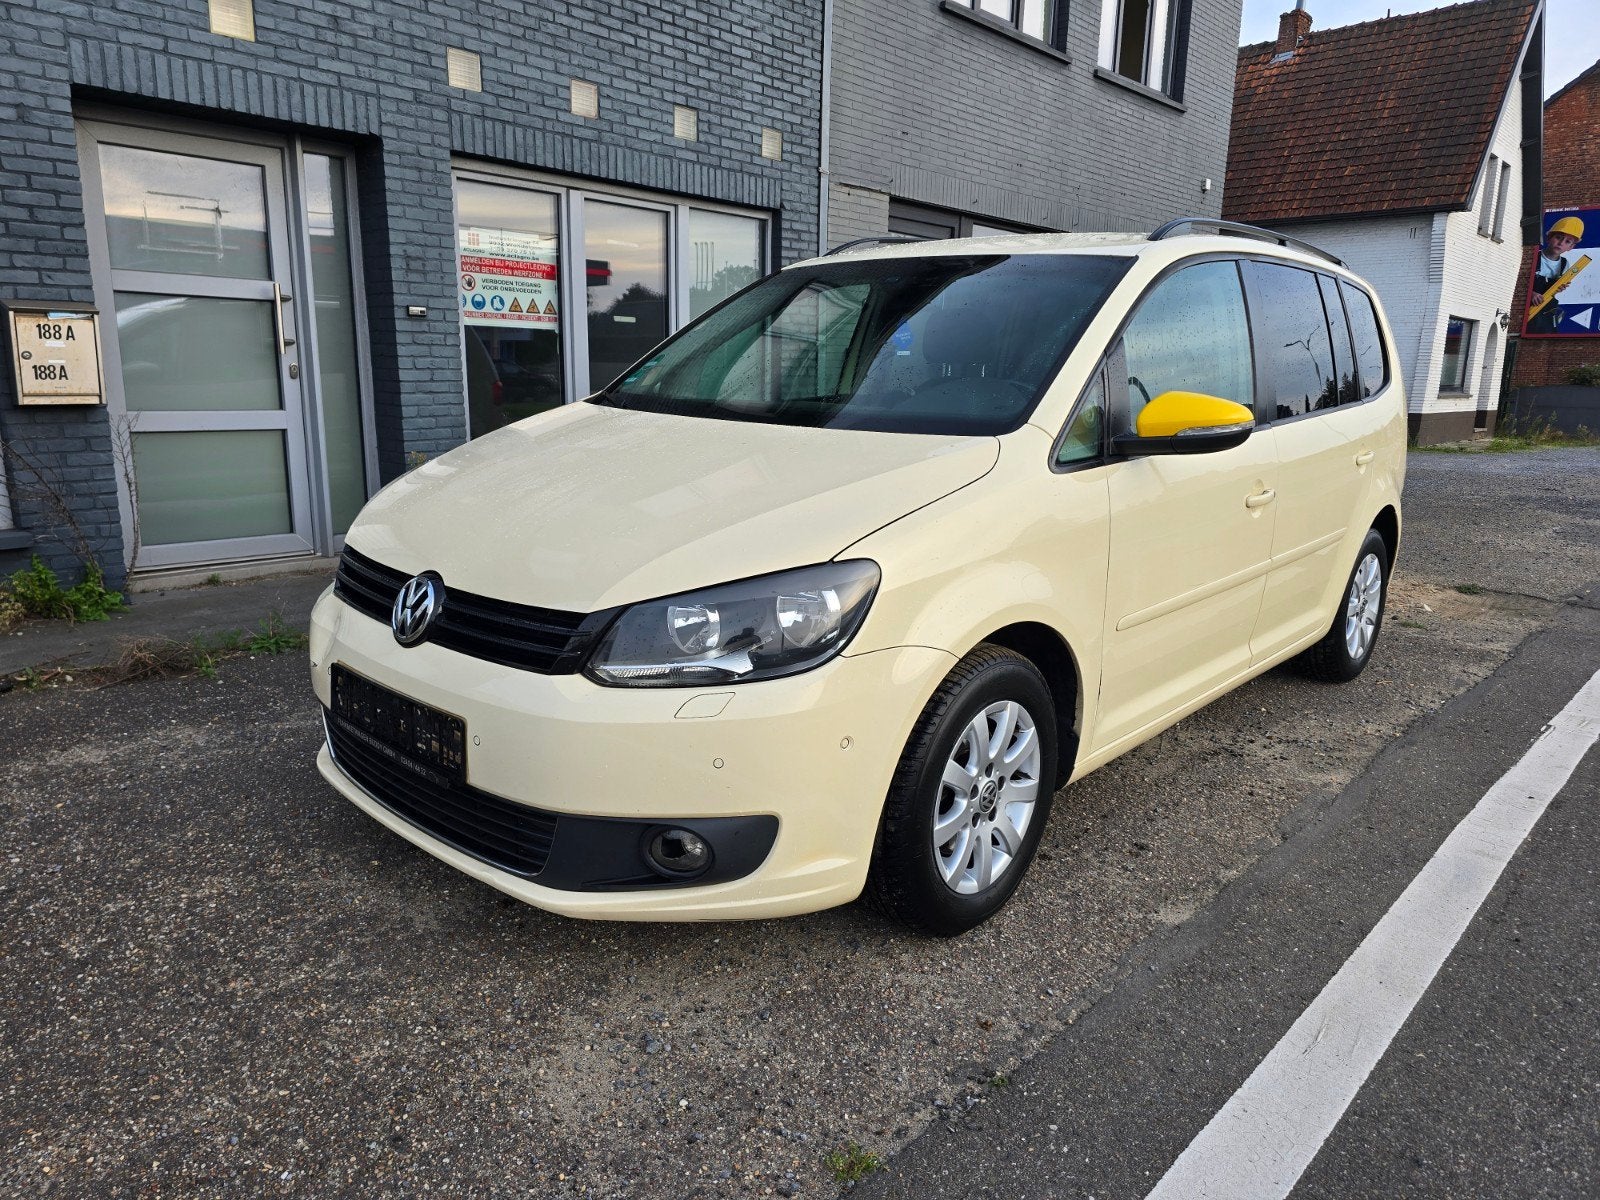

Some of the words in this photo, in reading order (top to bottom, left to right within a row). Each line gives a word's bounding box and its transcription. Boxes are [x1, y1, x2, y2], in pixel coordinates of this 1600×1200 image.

[462, 257, 495, 266] ANMELDEN
[505, 261, 551, 271] PROJECTLEIDING
[482, 267, 512, 276] BETREDEN
[482, 278, 514, 286] VERBODEN
[515, 280, 542, 288] TOEGANG
[500, 286, 542, 294] ONBEVOEGDEN
[36, 323, 62, 340] 188
[66, 325, 76, 341] A
[32, 364, 57, 380] 188
[59, 365, 69, 381] A
